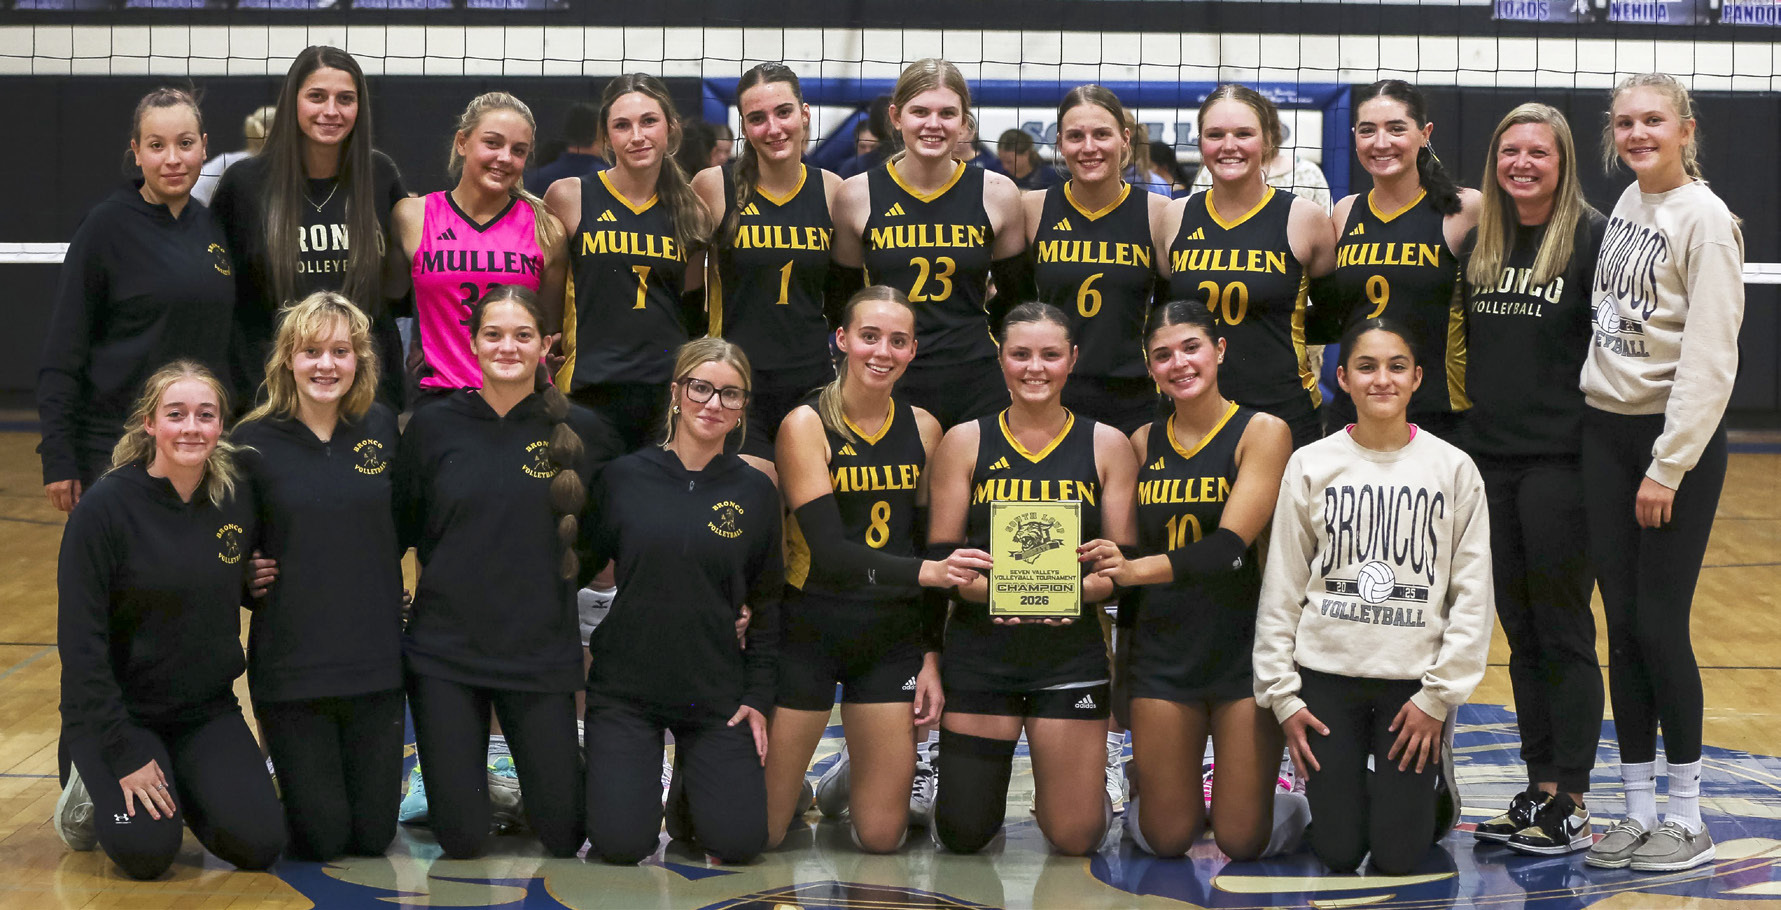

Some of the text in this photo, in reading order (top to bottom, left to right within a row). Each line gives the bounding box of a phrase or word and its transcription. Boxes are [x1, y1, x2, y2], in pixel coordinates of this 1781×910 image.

[1724, 5, 1781, 24] PANDO
[871, 224, 986, 251] MULLEN
[421, 250, 538, 276] MULLEN
[1037, 240, 1151, 269] MULLEN
[1171, 249, 1286, 274] MULLEN
[1336, 242, 1440, 268] MULLEN
[632, 265, 652, 310] 7
[776, 259, 794, 305] 1
[908, 256, 956, 303] 23
[459, 282, 503, 326] 3
[1077, 272, 1104, 318] 6
[1197, 281, 1249, 326] 20
[1365, 274, 1390, 320] 9
[353, 438, 383, 453] BRONCO
[973, 478, 1096, 506] MULLEN
[711, 500, 744, 515] BRONCO
[216, 523, 243, 539] BRONCO
[865, 500, 891, 549] 8
[1005, 512, 1037, 533] SOUTH
[1165, 513, 1203, 552] 10
[1321, 484, 1445, 587] BRONCOS
[997, 584, 1074, 592] CHAMPION
[1020, 596, 1050, 605] 2026
[1336, 582, 1417, 597] 20 25
[1321, 598, 1426, 627] VOLLEYBALL
